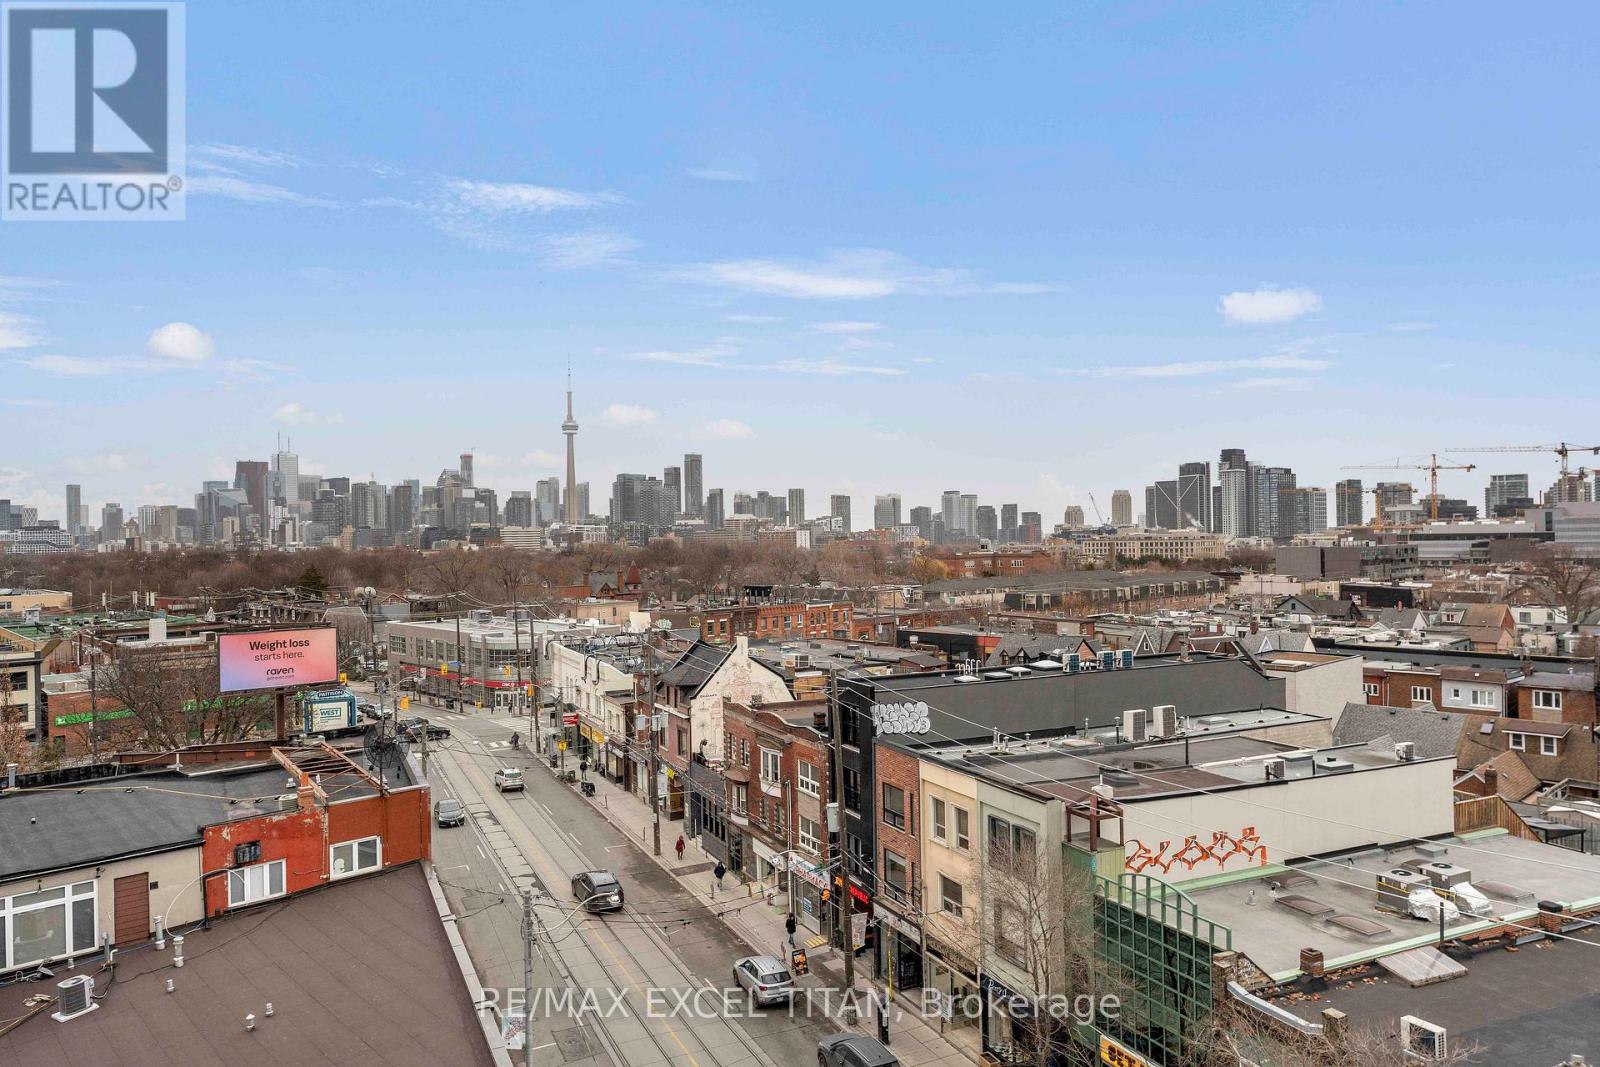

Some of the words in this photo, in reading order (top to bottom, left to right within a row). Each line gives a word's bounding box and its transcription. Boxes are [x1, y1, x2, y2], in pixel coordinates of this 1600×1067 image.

[249, 640, 287, 651] Weight
[289, 639, 310, 648] loss
[254, 652, 281, 662] starts
[283, 651, 305, 660] here.
[266, 667, 294, 676] raven
[320, 709, 339, 717] WEST
